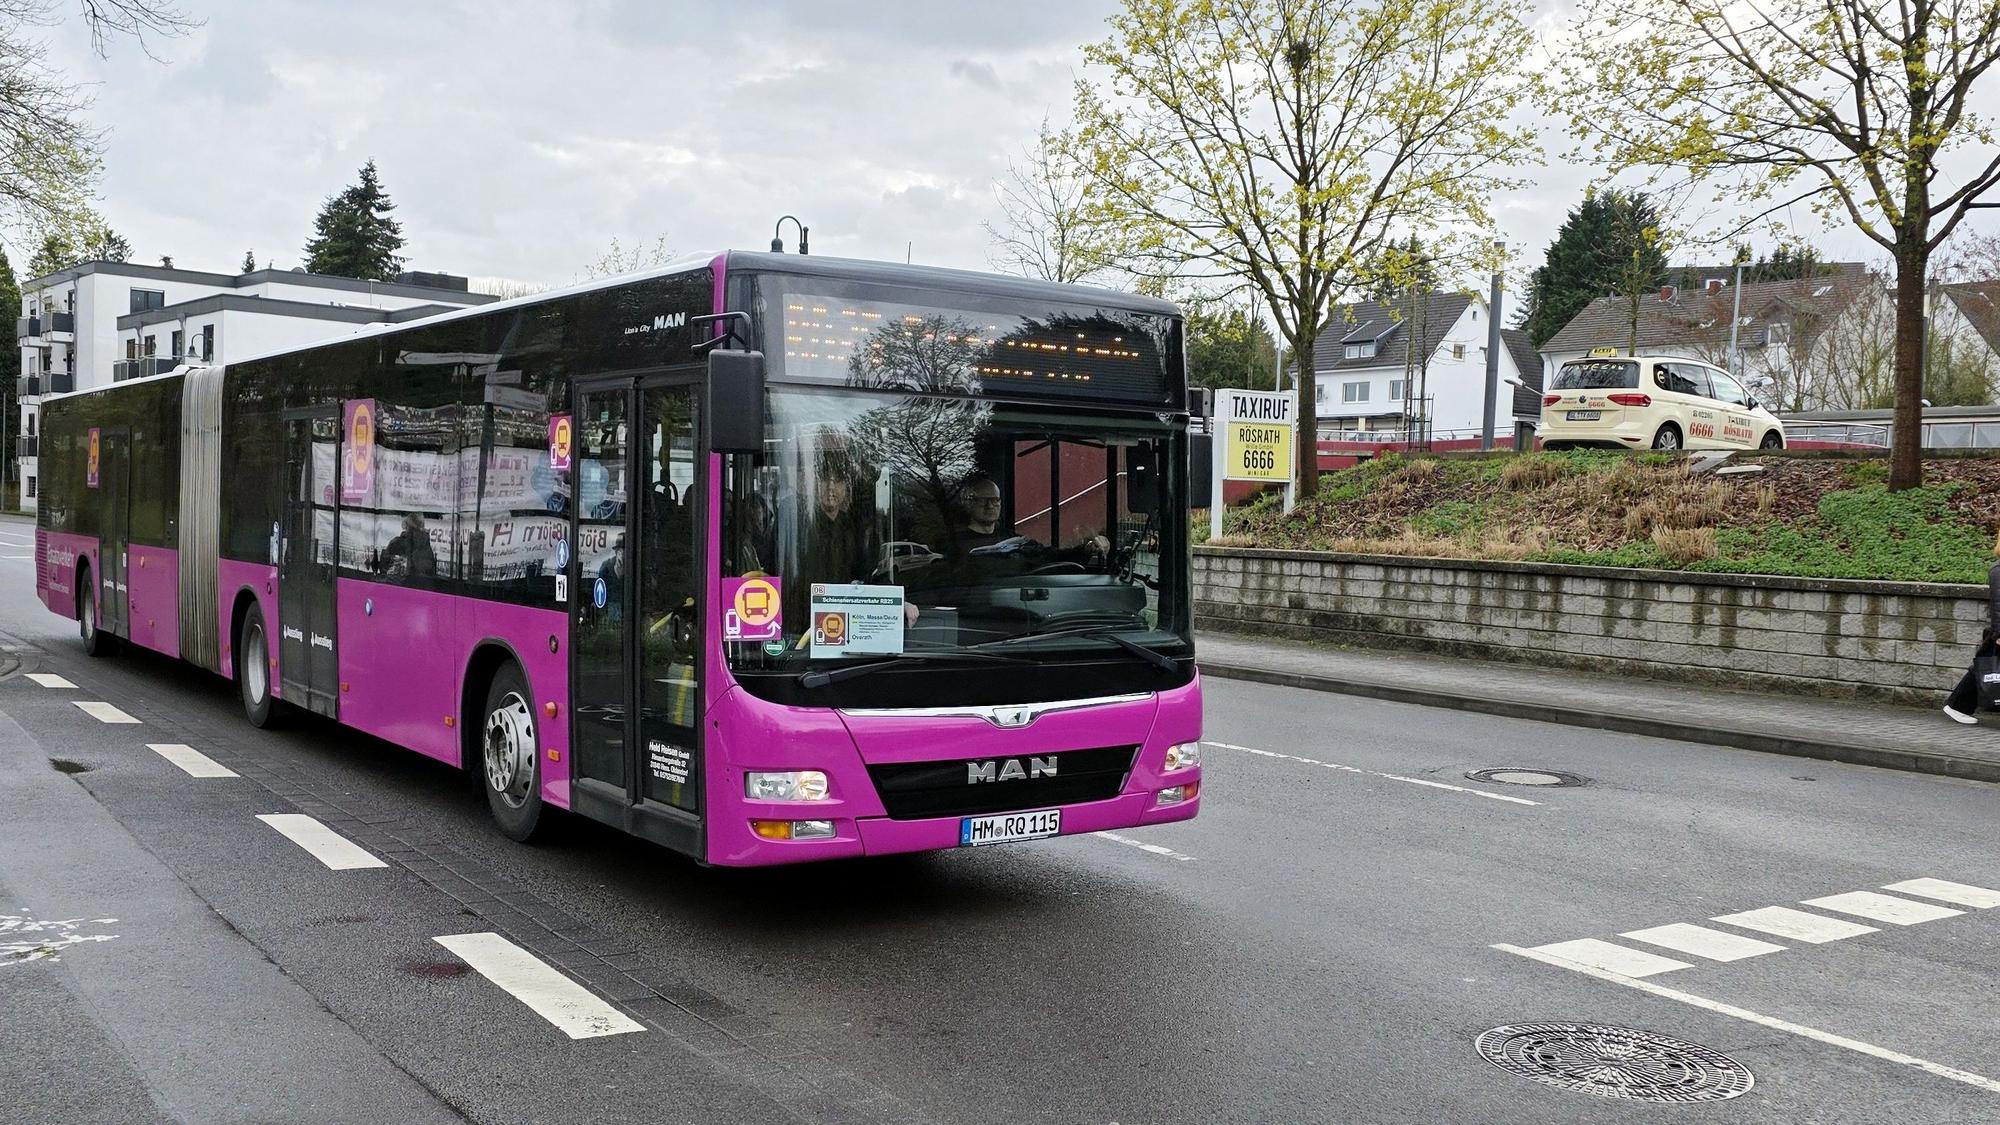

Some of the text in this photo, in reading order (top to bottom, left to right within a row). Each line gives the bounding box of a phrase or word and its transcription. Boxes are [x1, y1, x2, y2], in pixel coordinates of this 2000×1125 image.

[654, 312, 686, 330] MAN
[1232, 396, 1289, 420] TAXIRUF
[1689, 422, 1714, 438] 6666
[1728, 415, 1751, 427] TAXIRUF
[1239, 426, 1280, 444] RÖSRATH
[1724, 425, 1753, 439] RÖSRATH
[1243, 450, 1274, 469] 6666
[966, 756, 1058, 785] MAN
[972, 813, 1059, 840] HM RQ 115
